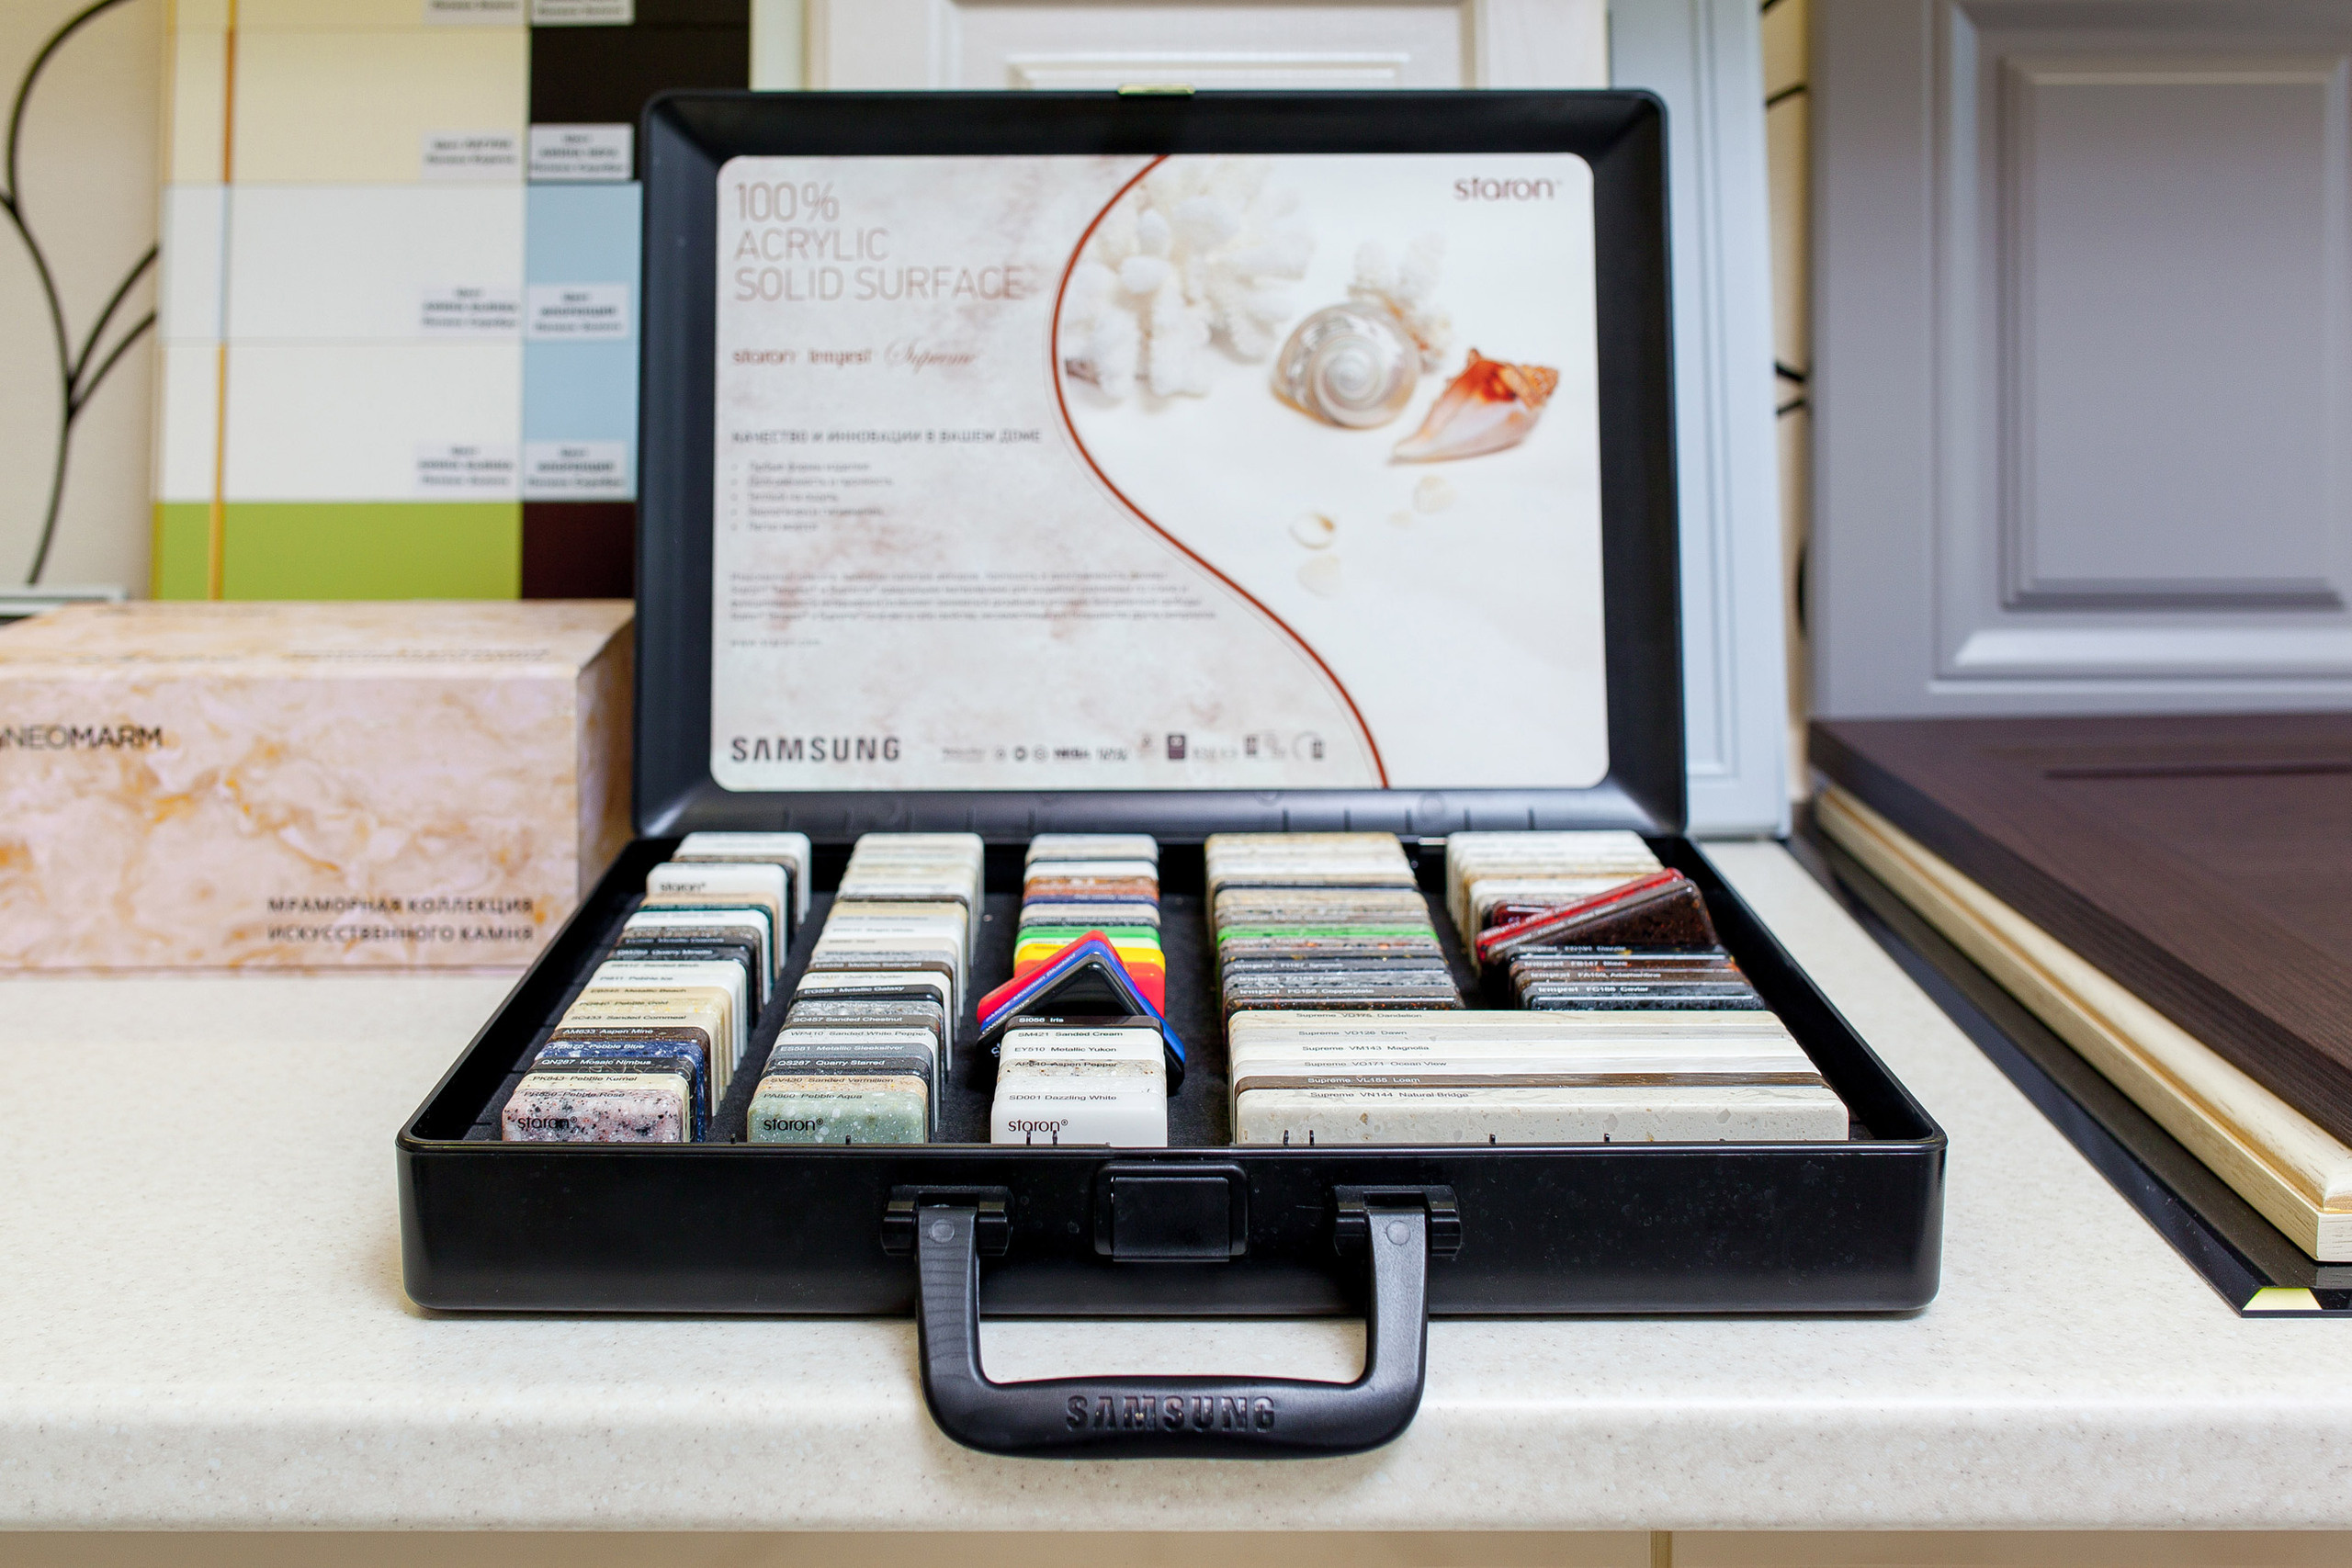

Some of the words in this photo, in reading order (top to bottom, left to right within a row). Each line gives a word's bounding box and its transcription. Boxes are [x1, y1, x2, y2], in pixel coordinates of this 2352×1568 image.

[736, 182, 840, 222] 100%
[735, 228, 890, 262] ACRYLIC
[735, 265, 844, 302] SOLID
[854, 265, 1025, 301] SURFACE
[731, 737, 900, 762] SAMSUNG
[268, 897, 401, 911] МРАМОРНАЯ
[407, 897, 533, 914] КОЛЛЕКЦИЯ
[268, 925, 455, 942] ИСКУССТВЕННОГО
[460, 925, 533, 941] КАМНЯ
[1066, 1394, 1276, 1432] SAMSUNG
